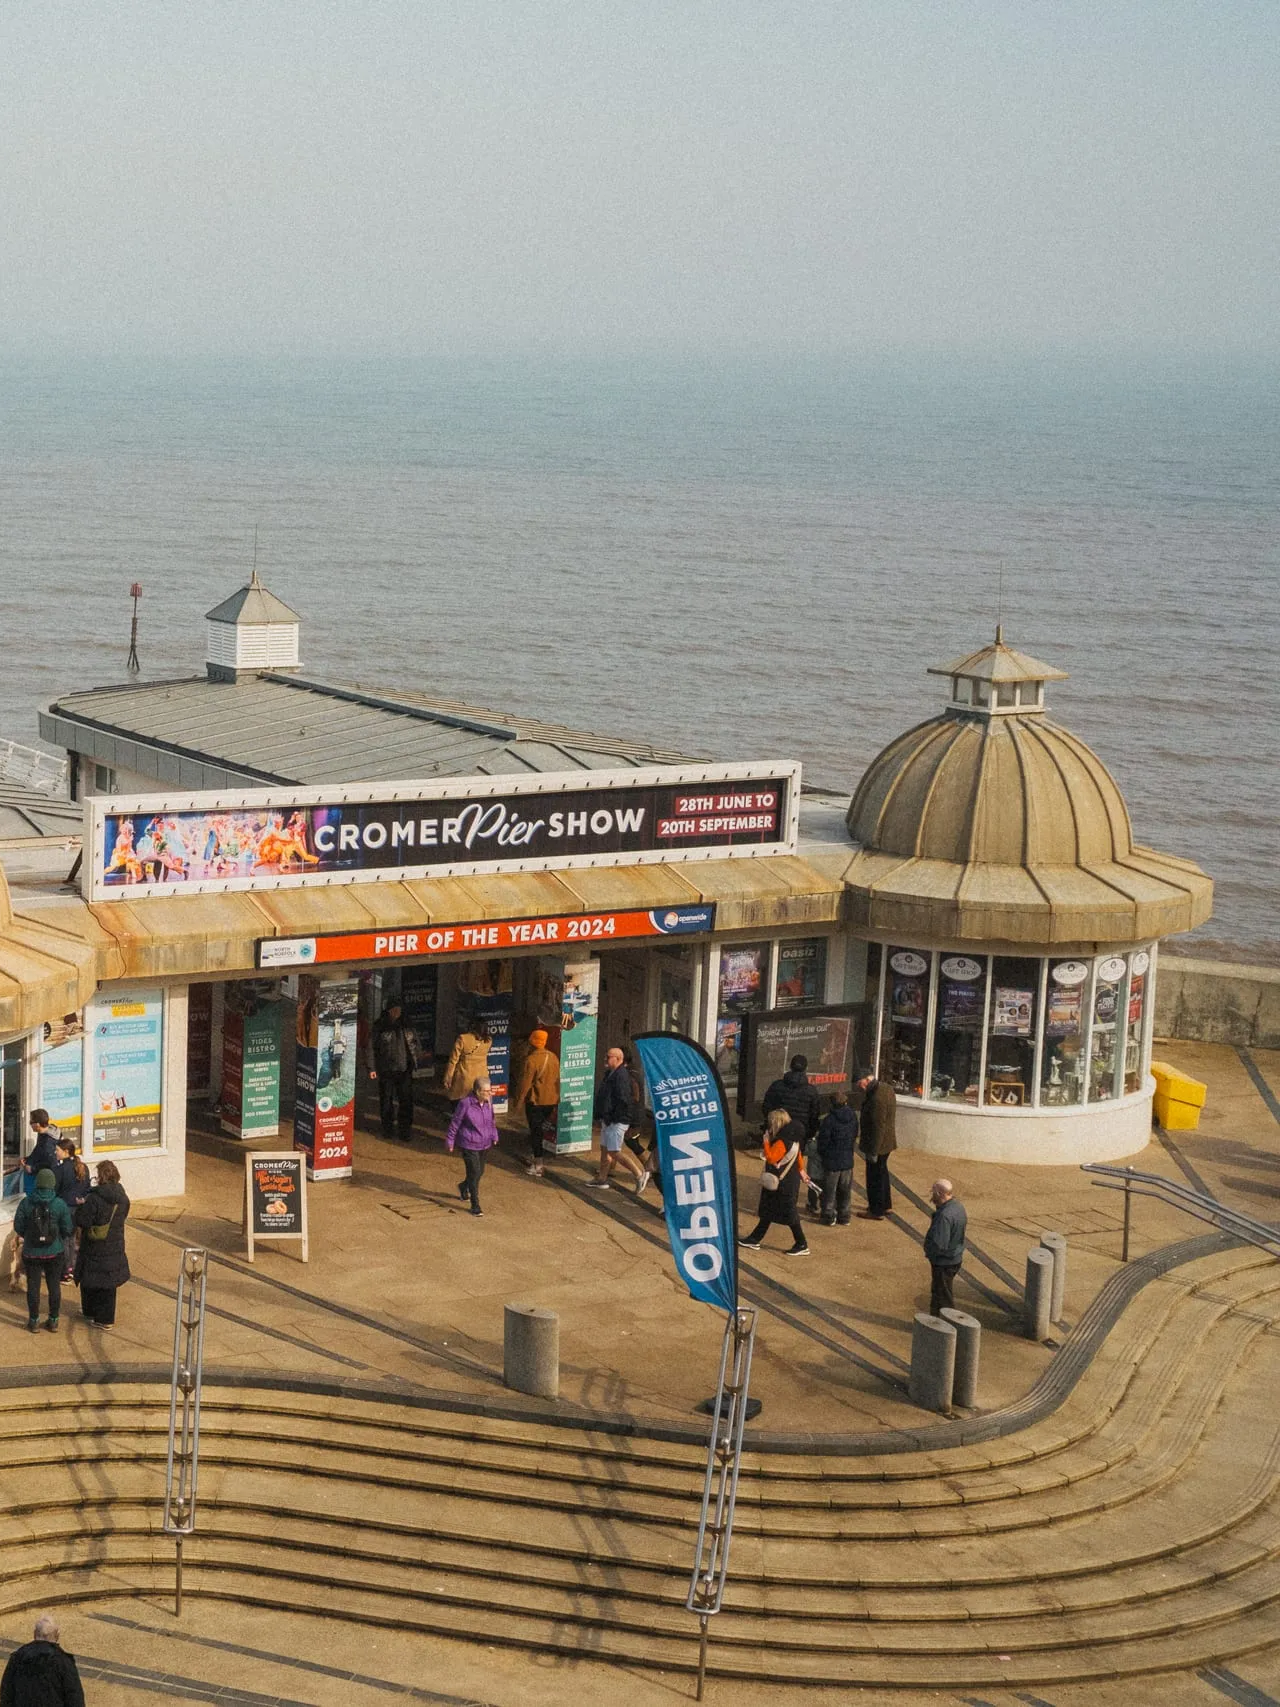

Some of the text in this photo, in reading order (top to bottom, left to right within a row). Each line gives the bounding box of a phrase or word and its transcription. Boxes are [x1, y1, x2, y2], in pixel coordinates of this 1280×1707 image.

[679, 793, 774, 812] 28TH JUNE TO
[314, 803, 646, 852] CROMER Pier SHOW
[661, 815, 773, 835] 20TH SEPTEMBER
[375, 917, 616, 954] PIER OF THE YEAR 2024
[782, 947, 816, 959] oasiz
[251, 1037, 272, 1045] TIDES
[247, 1044, 276, 1053] BISTRO
[564, 1059, 591, 1068] BISTRO
[297, 1078, 315, 1093] SHOW
[319, 1145, 348, 1159] 2024
[278, 1161, 299, 1169] Pier
